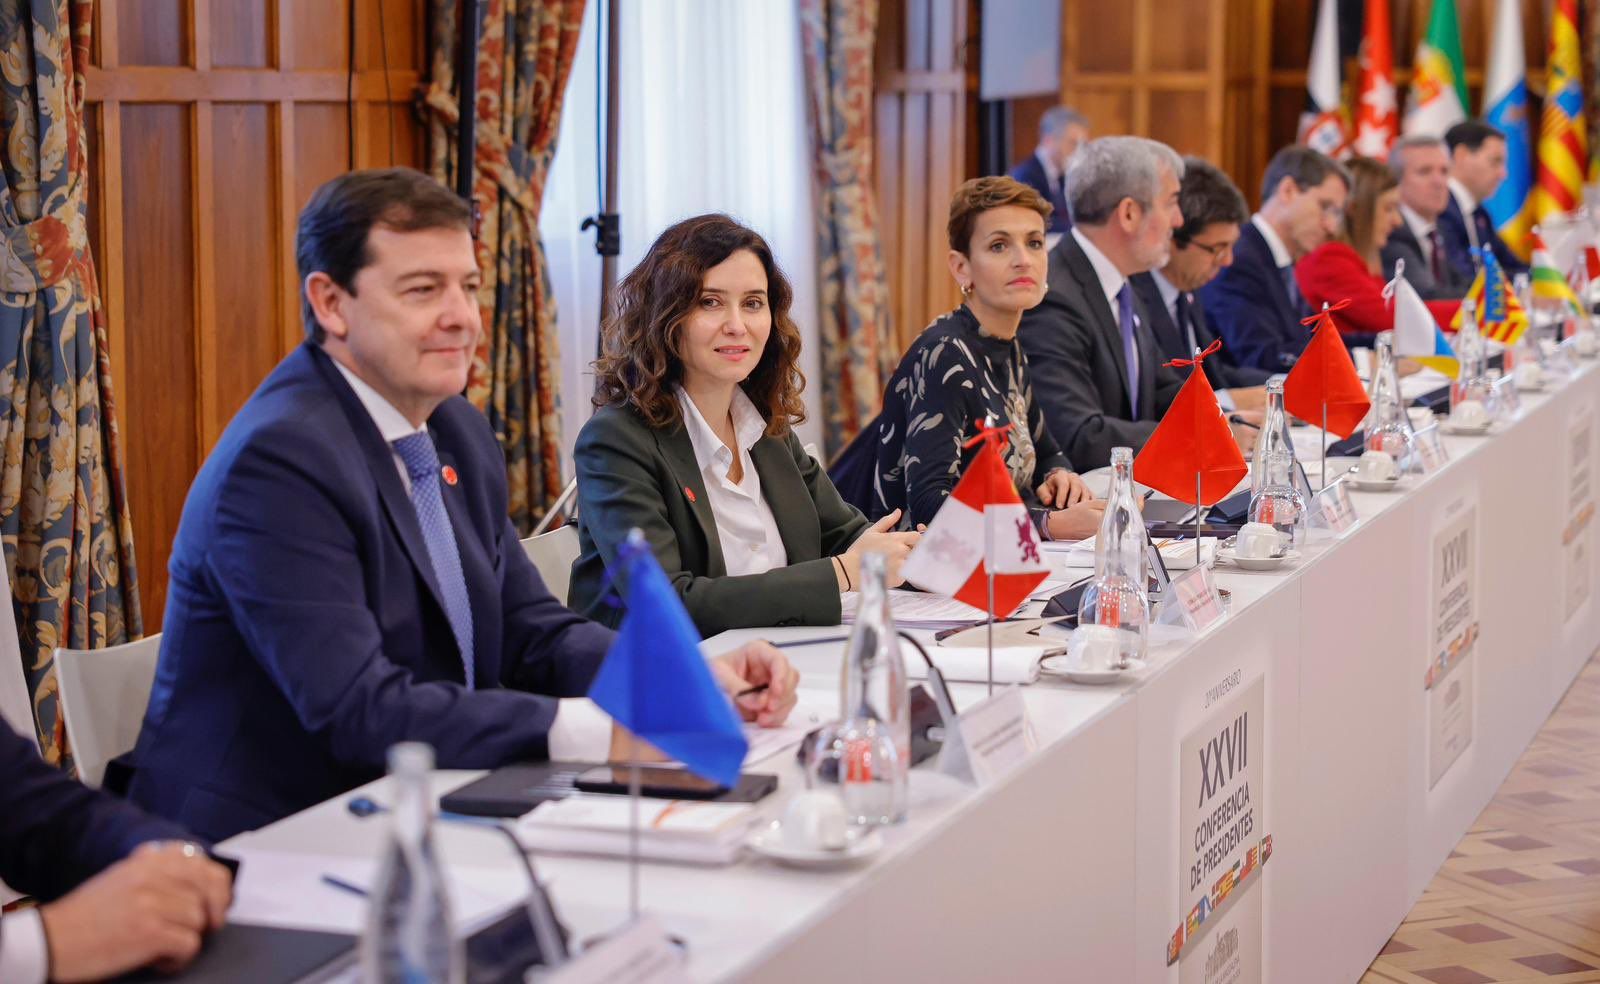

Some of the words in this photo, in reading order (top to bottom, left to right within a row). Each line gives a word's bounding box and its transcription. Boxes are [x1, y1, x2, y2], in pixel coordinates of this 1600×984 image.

[1198, 711, 1248, 809] XXVII
[1190, 857, 1202, 892] DE
[1203, 808, 1254, 878] PRESIDENTES
[1194, 781, 1250, 852] CONFERENCIA
